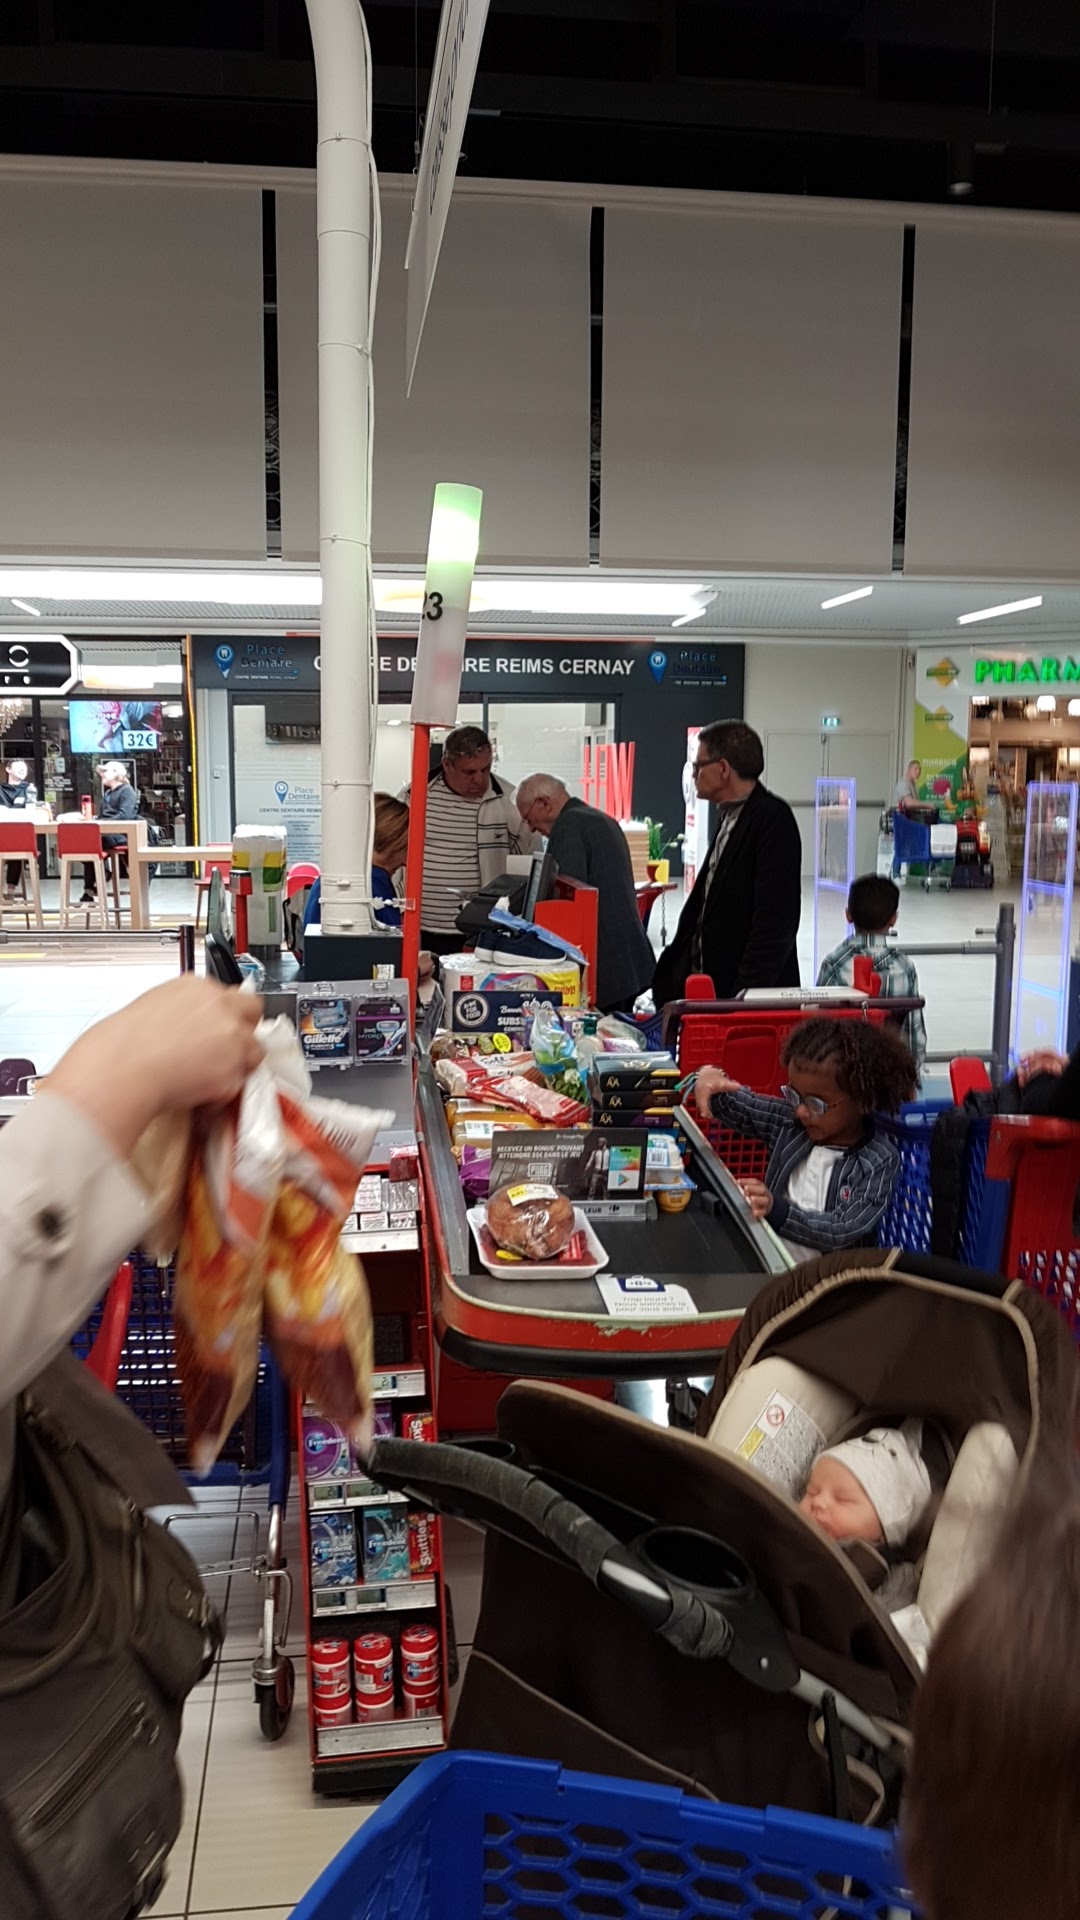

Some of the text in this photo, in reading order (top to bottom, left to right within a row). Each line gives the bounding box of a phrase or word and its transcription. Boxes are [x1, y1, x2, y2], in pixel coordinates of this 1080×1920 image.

[247, 644, 285, 655] Place
[680, 651, 717, 662] Place
[241, 657, 293, 669] Dentaire
[495, 658, 554, 674] REIMS
[559, 659, 635, 675] CERNAY
[127, 733, 154, 747] 32€
[294, 786, 314, 795] Place
[466, 1011, 480, 1020] FOOD
[303, 1033, 342, 1045] Gillette
[499, 1151, 531, 1159] ATTEINDRE
[530, 1164, 549, 1175] PUBG
[308, 1437, 346, 1448] Freedent
[368, 1539, 406, 1549] Freedent
[417, 1519, 433, 1566] Skittles
[314, 1545, 353, 1555] Freedent
